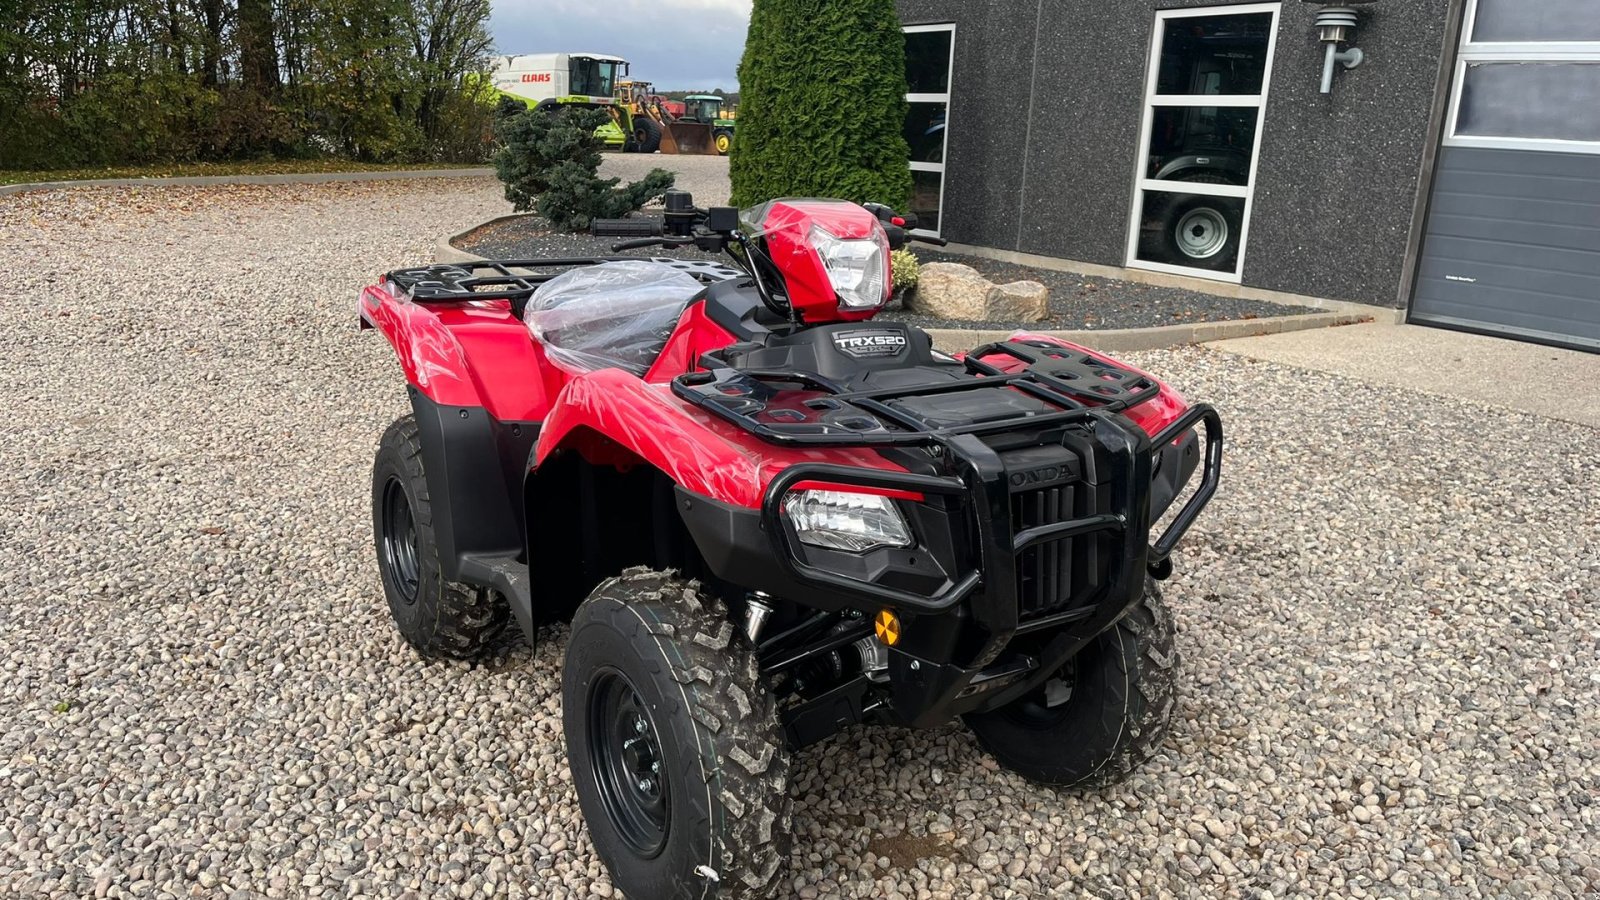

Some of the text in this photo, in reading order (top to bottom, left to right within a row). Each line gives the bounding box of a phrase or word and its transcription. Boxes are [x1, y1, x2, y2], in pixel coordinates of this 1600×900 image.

[521, 73, 551, 83] CLAAS
[834, 336, 906, 348] TRX520
[1009, 464, 1076, 487] ONDA
